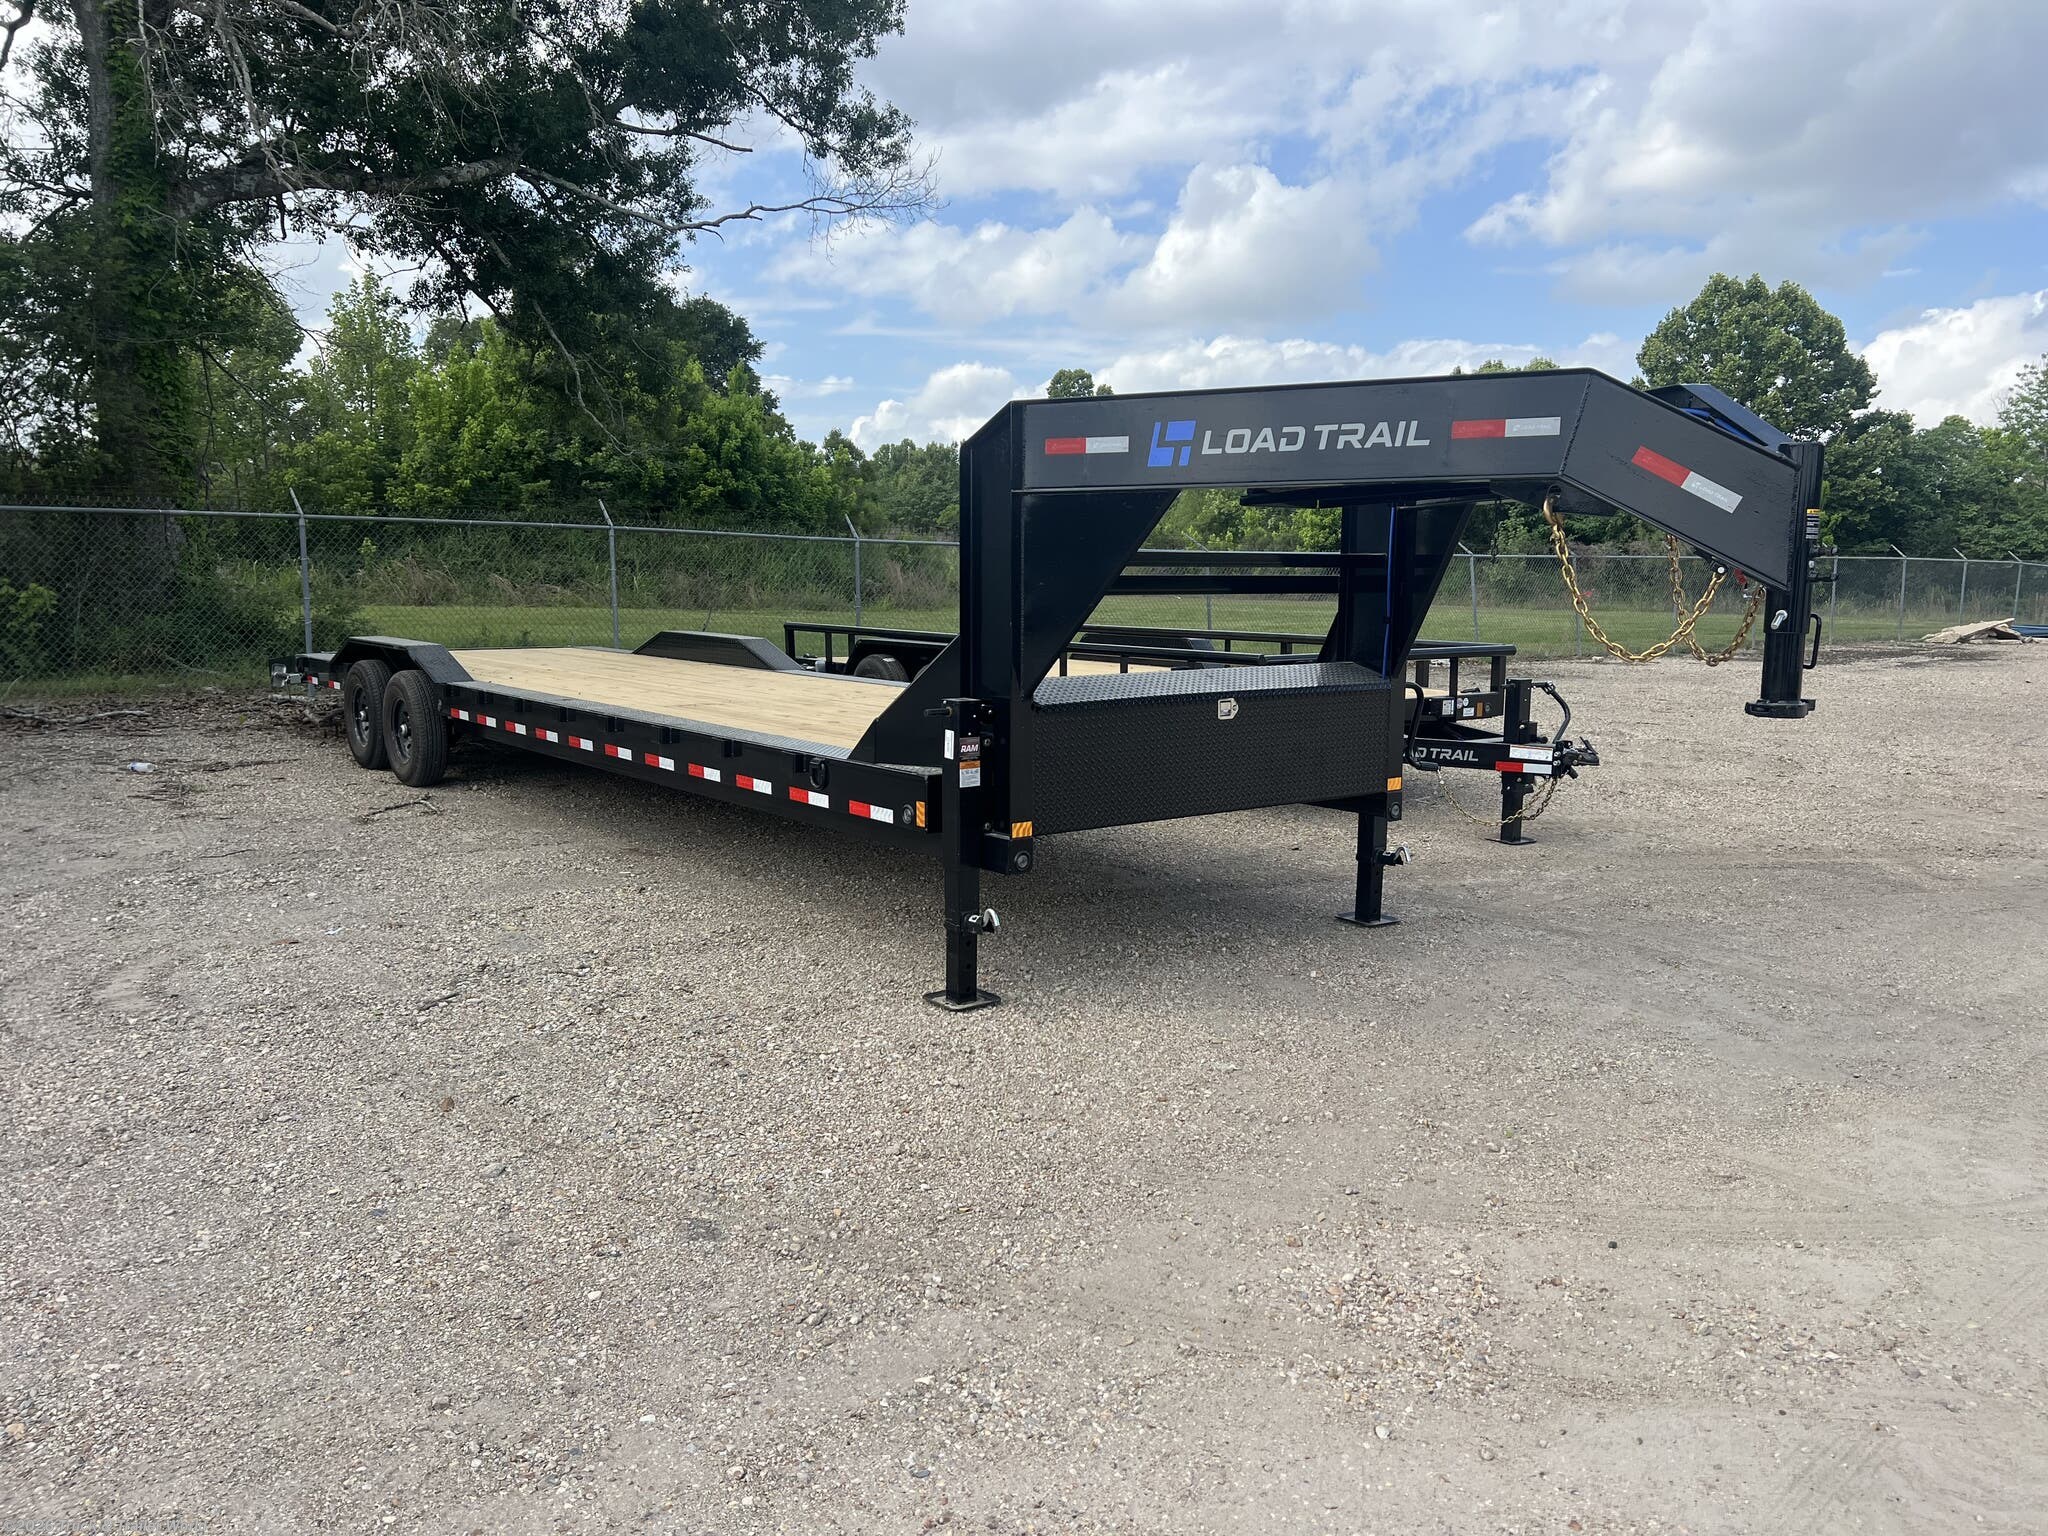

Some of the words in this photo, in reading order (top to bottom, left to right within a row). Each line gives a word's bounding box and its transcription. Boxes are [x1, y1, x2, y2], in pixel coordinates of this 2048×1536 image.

[1201, 425, 1306, 455] LOAD
[1313, 420, 1431, 450] TRAIL
[960, 744, 979, 753] RAM
[1430, 748, 1479, 761] TRAIL
